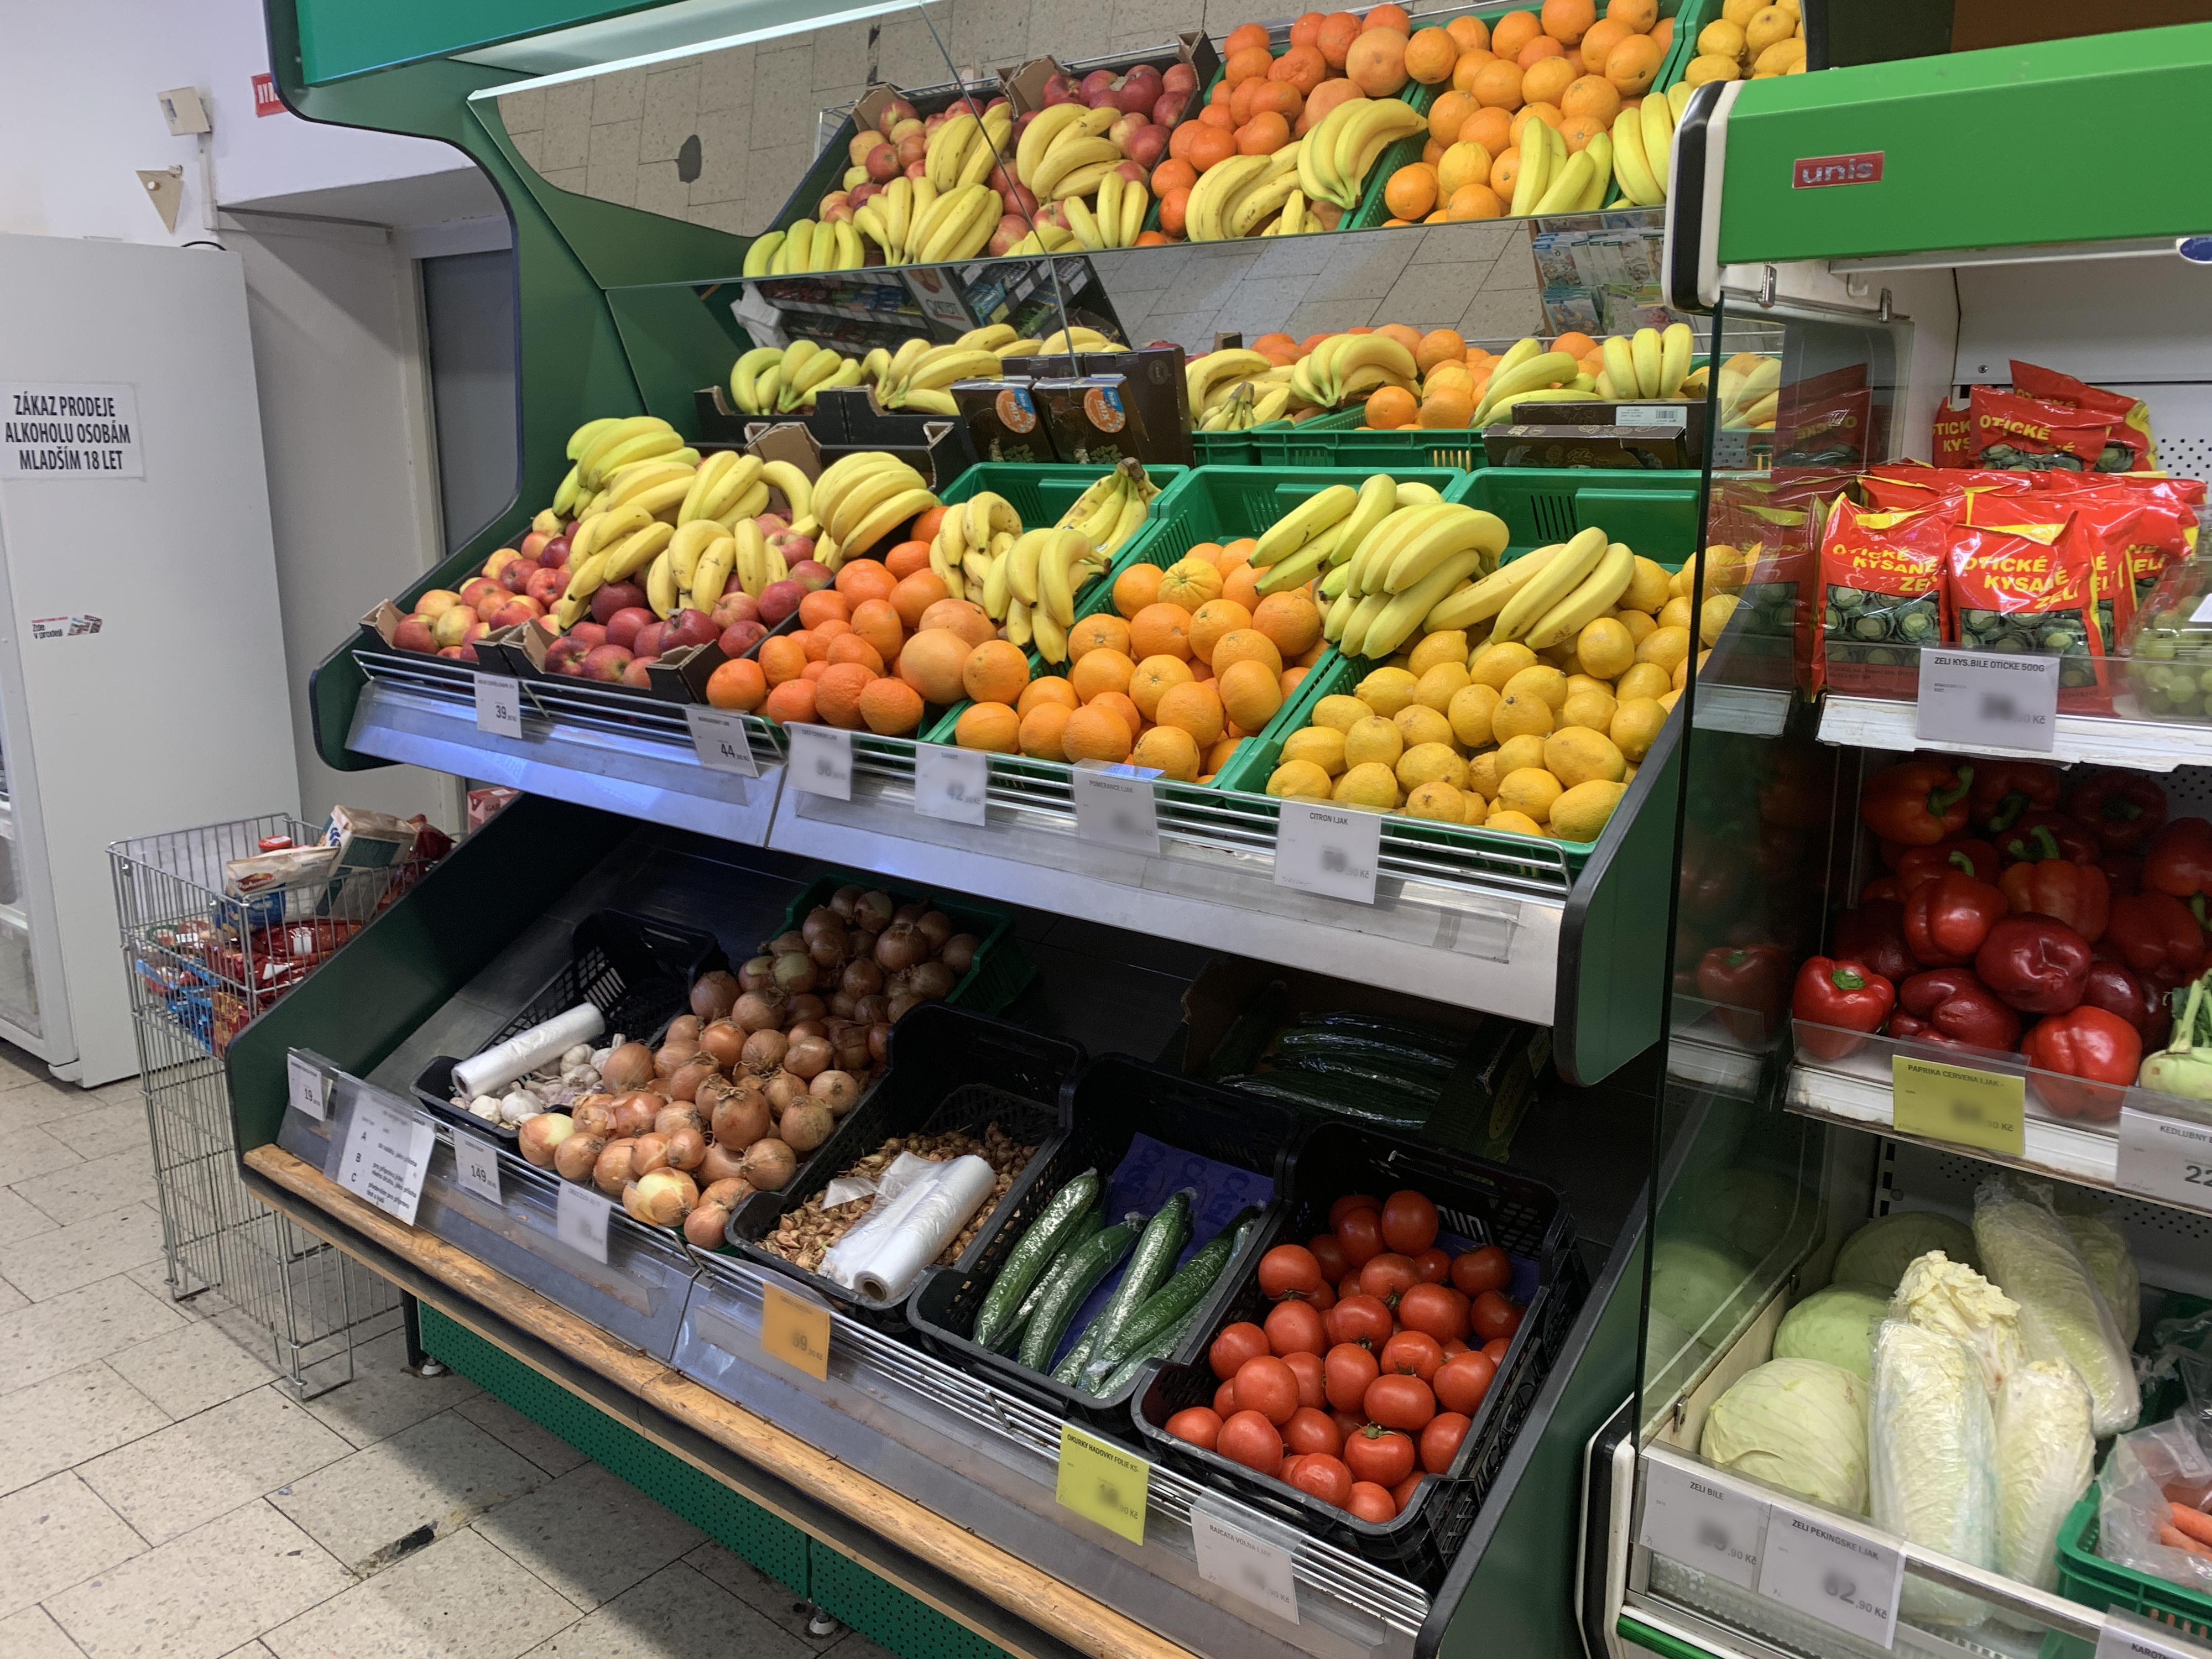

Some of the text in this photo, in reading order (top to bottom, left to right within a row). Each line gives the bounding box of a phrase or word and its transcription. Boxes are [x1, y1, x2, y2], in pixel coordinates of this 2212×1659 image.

[1802, 158, 1873, 184] unis
[13, 390, 116, 417] ZÁKAZ PRODEJE
[6, 420, 131, 444] ALKOHOLU OSOBÁM
[1933, 420, 1970, 435] TICK
[1980, 415, 2051, 440] OTICKÉ
[1943, 437, 1970, 452] KYS
[19, 446, 123, 470] MLADŠÍM 18 LET
[1963, 556, 2048, 573] OTICKÉ
[1991, 661, 2019, 670] OTICKE
[2021, 663, 2044, 672] 500G
[496, 705, 506, 719] 39
[721, 743, 735, 759] 44
[1089, 780, 1120, 791] POMERANCE
[1310, 812, 1332, 823] CITRON
[1908, 1065, 1941, 1077] PAPRIKA
[1943, 1071, 1978, 1083] CERVENA
[305, 1088, 312, 1102] 19
[361, 1131, 366, 1141] A
[2160, 1125, 2208, 1141] KEDLUBNY
[356, 1152, 361, 1162] B
[351, 1172, 357, 1182] C
[471, 1165, 486, 1182] 149
[2185, 1165, 2212, 1188] 22
[1067, 1434, 1088, 1449] OKURKY
[1089, 1444, 1114, 1461] HADOVKY
[1114, 1457, 1129, 1469] FOLIE
[1690, 1481, 1724, 1500] ZELI BILE
[1210, 1525, 1234, 1542] RAJCATA
[1235, 1536, 1256, 1552] VOLNA
[1792, 1519, 1809, 1532] ZELI
[1811, 1527, 1857, 1551] PEKINGSKE
[1745, 1554, 1757, 1566] Kč
[1875, 1606, 1887, 1619] Kč
[2132, 1643, 2173, 1659] KAROT
